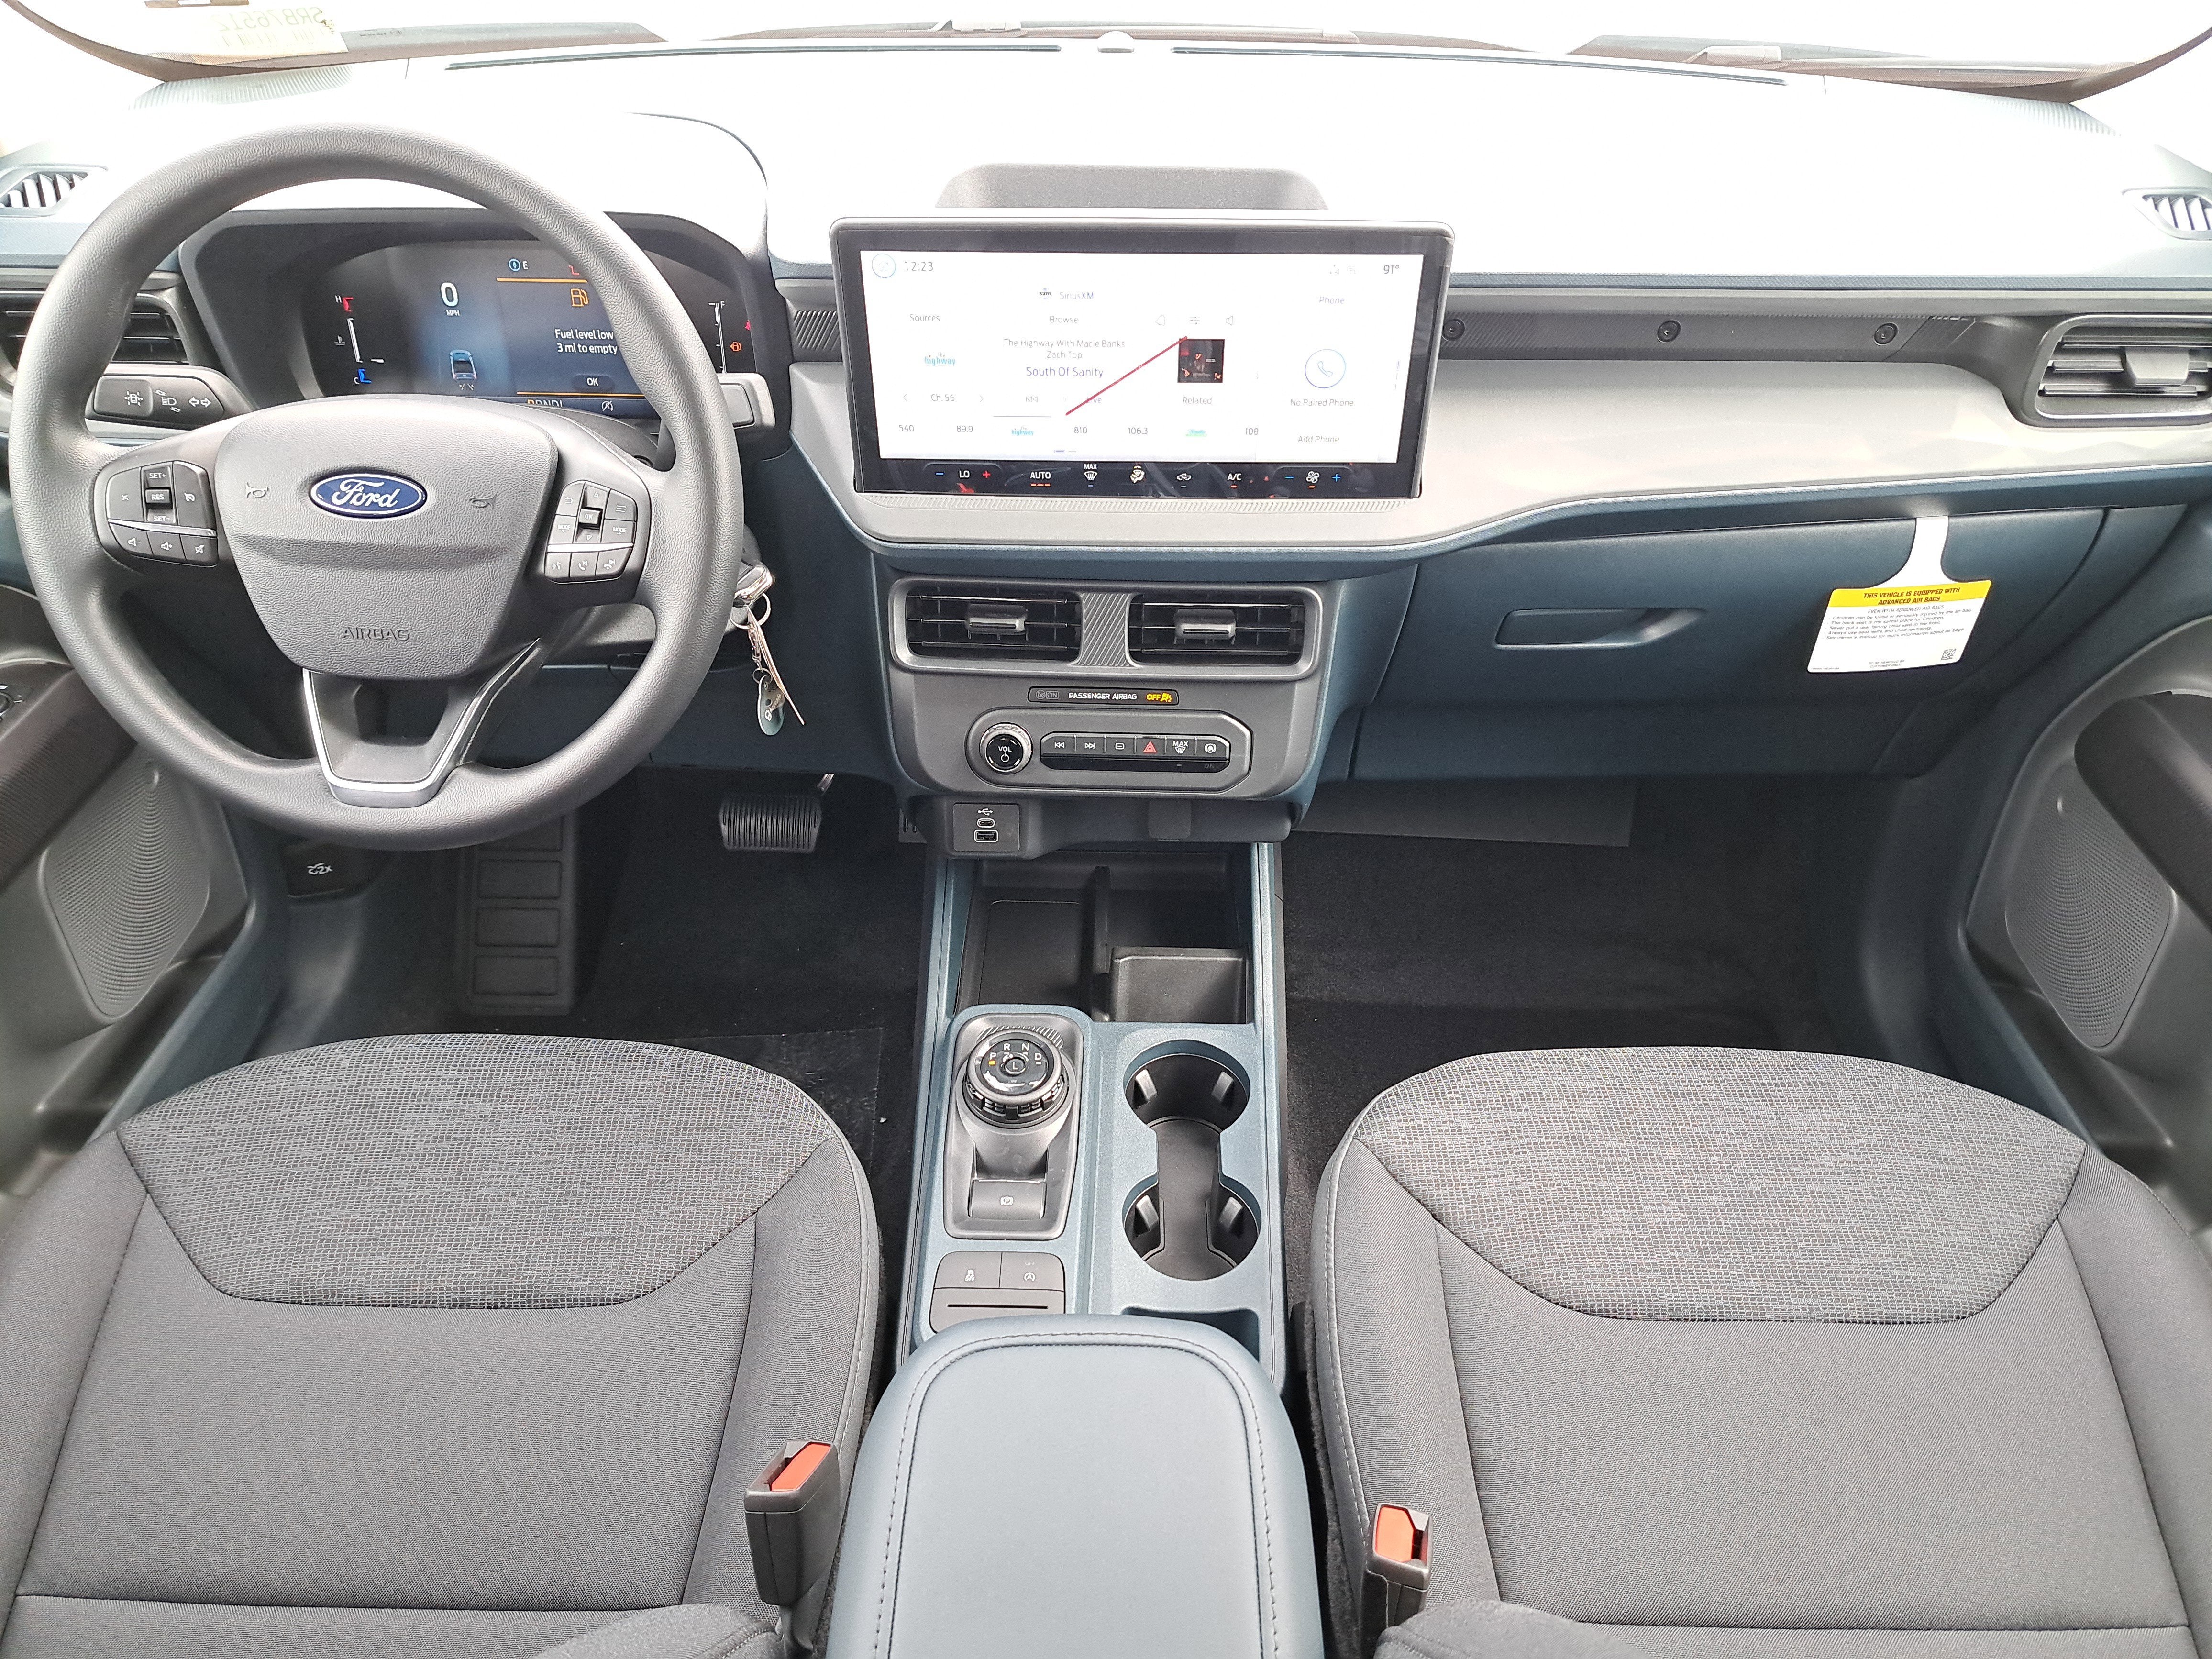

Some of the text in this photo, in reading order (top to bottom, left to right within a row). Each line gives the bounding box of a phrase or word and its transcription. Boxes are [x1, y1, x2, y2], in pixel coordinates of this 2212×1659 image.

[522, 261, 528, 270] E
[905, 261, 933, 272] 12:23
[335, 295, 342, 303] H
[440, 282, 459, 307] 0
[720, 301, 725, 310] F
[909, 314, 940, 322] Sources
[1050, 315, 1078, 323] Browse
[554, 329, 614, 340] Fuel level low
[1004, 339, 1018, 347] The
[1020, 339, 1054, 348] Highway
[557, 343, 563, 353] 3
[577, 343, 587, 353] to
[589, 344, 618, 355] empty
[1047, 351, 1082, 360] Zach Top
[924, 355, 956, 366] highway
[1026, 367, 1103, 377] South Of Sanity
[586, 377, 599, 387] OK
[931, 394, 943, 402] Ch.
[899, 424, 914, 432] 540
[959, 470, 970, 478] LO
[1030, 471, 1051, 479] AUTO
[1227, 473, 1242, 481] A/C
[332, 479, 401, 508] Ford
[343, 627, 410, 641] AIRBAG
[1012, 1062, 1018, 1070] L
